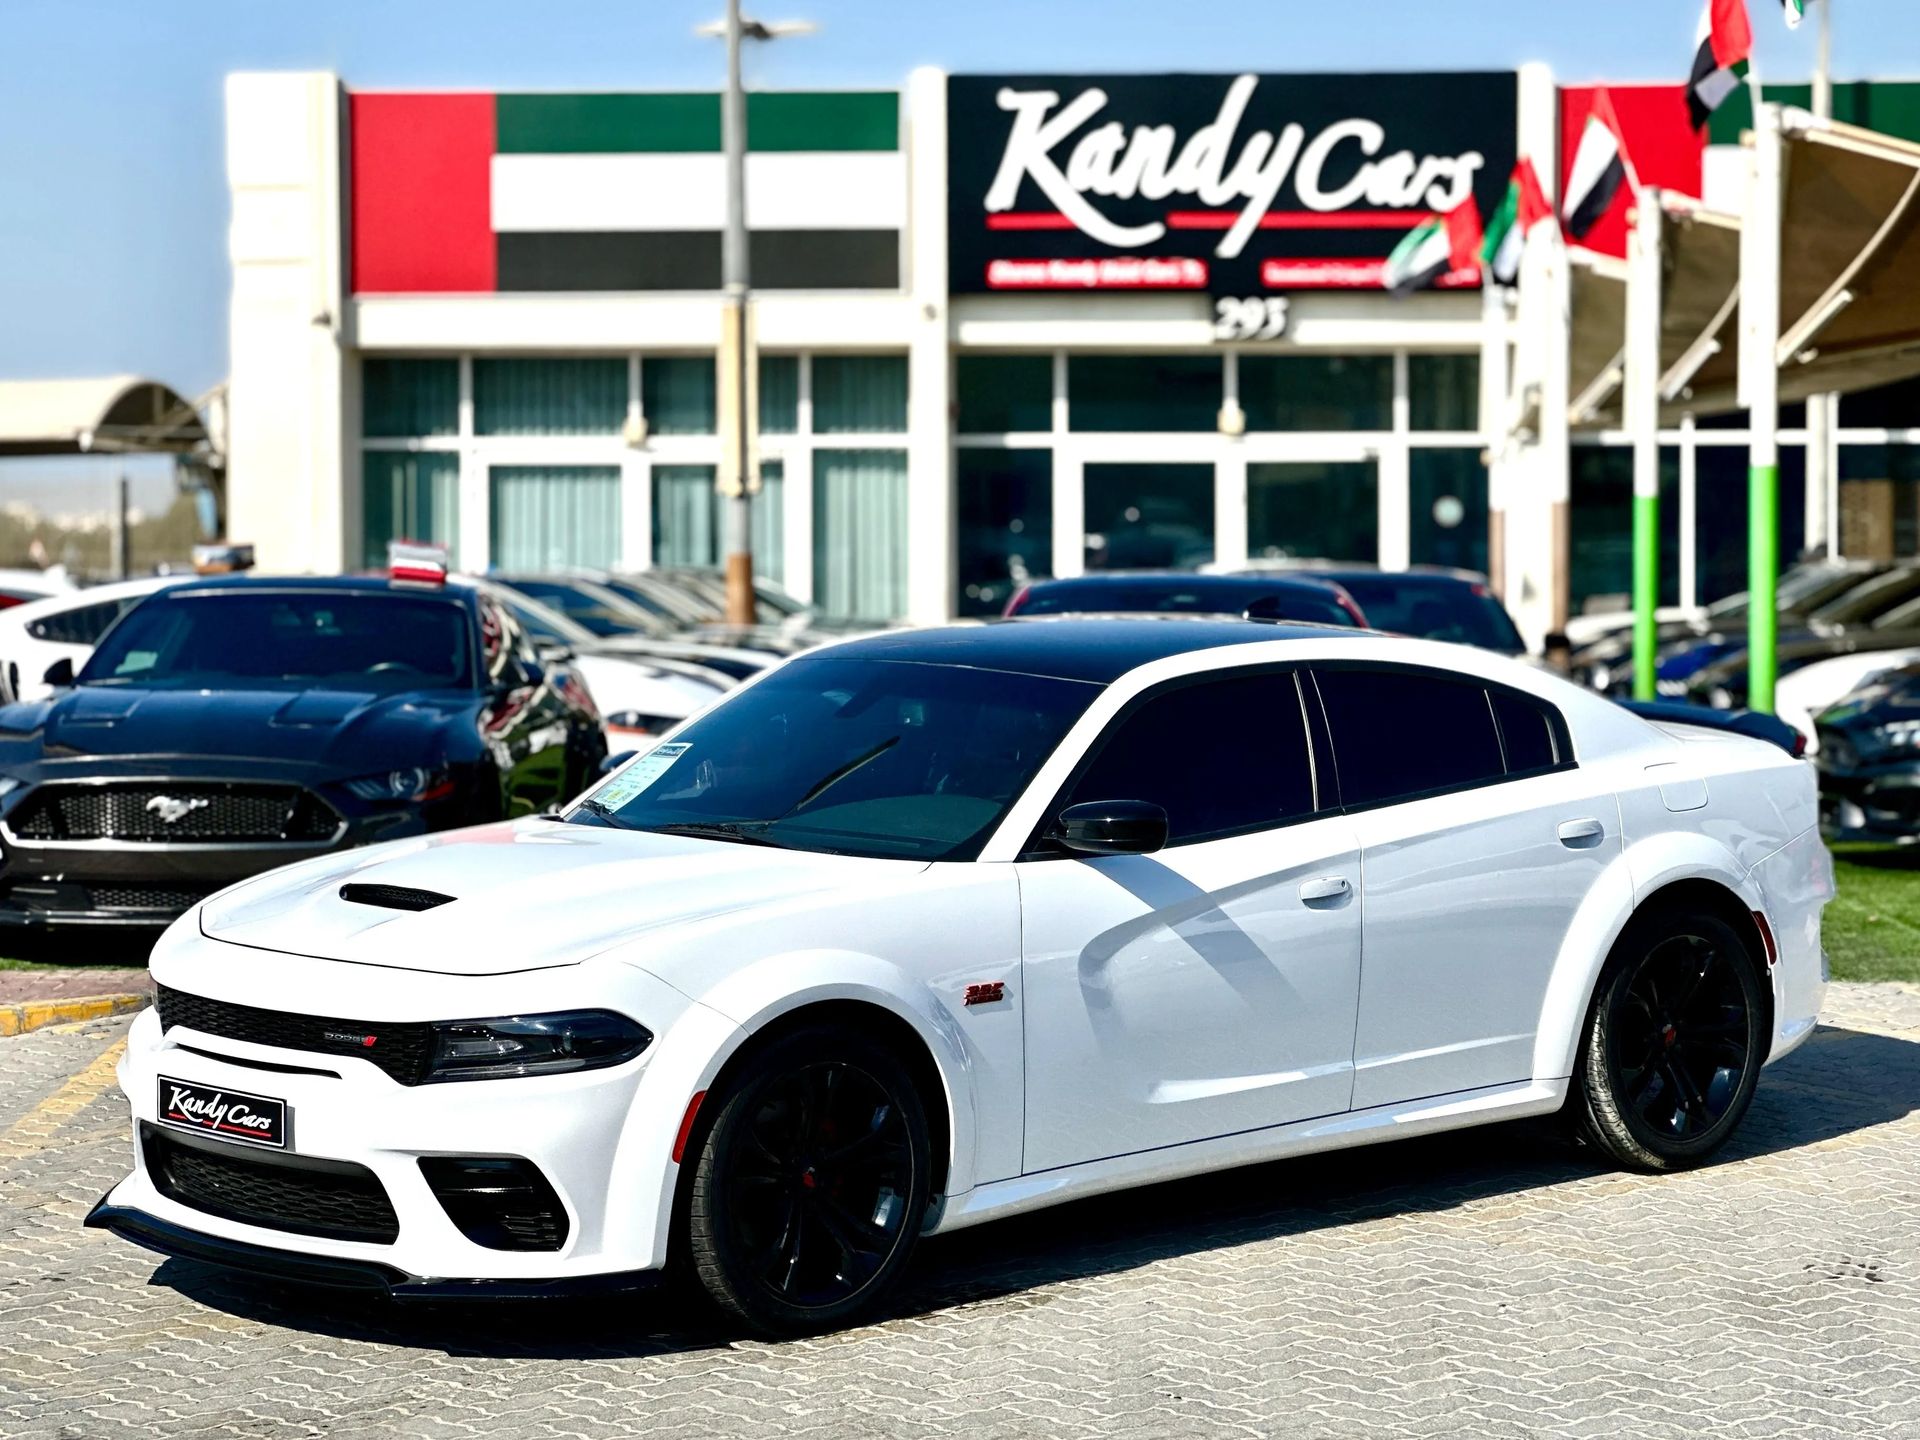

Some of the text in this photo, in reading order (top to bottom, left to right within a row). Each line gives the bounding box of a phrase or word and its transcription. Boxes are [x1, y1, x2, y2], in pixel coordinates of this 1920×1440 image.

[984, 74, 1484, 258] Kandy Cars
[168, 1085, 272, 1129] Kandy Cars
